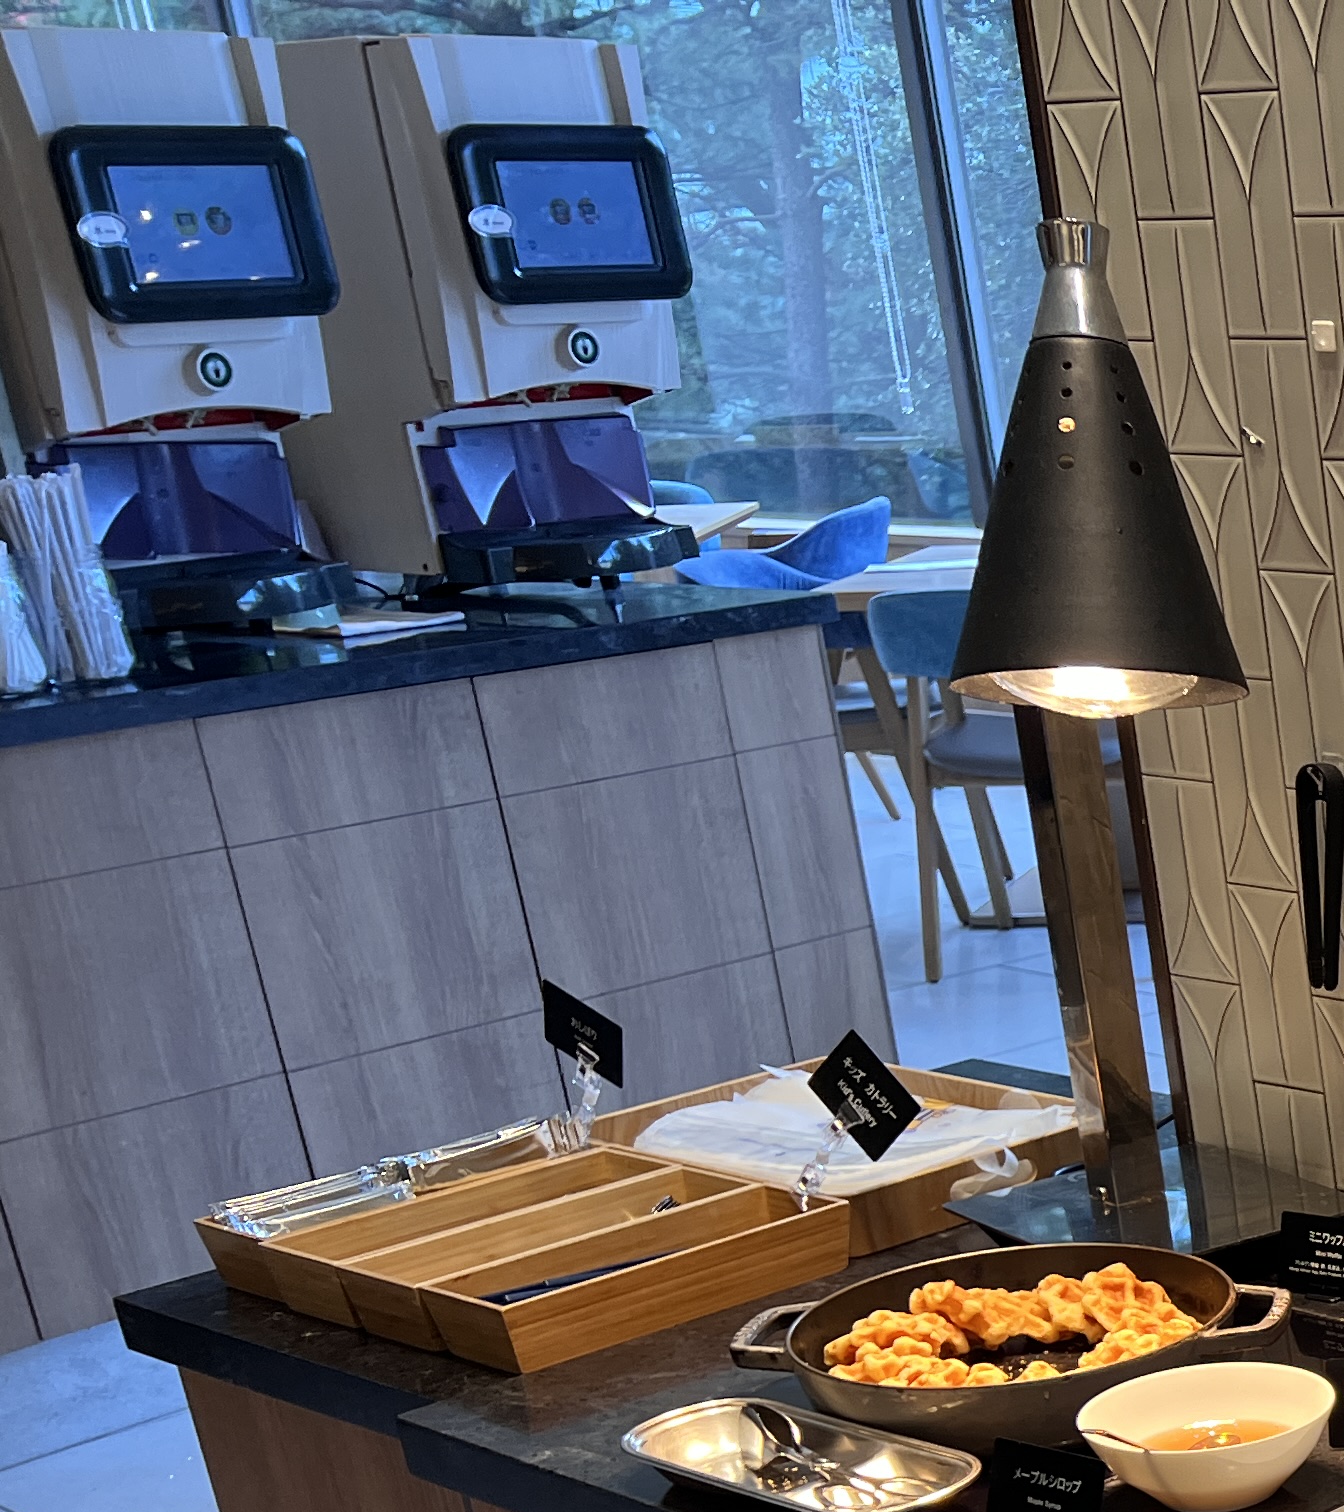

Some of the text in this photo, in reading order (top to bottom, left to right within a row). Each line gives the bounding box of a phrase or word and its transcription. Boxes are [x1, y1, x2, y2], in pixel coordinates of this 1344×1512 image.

[842, 1056, 898, 1120] キッズ カトラリー
[1012, 1467, 1083, 1494] メープルシロップ
